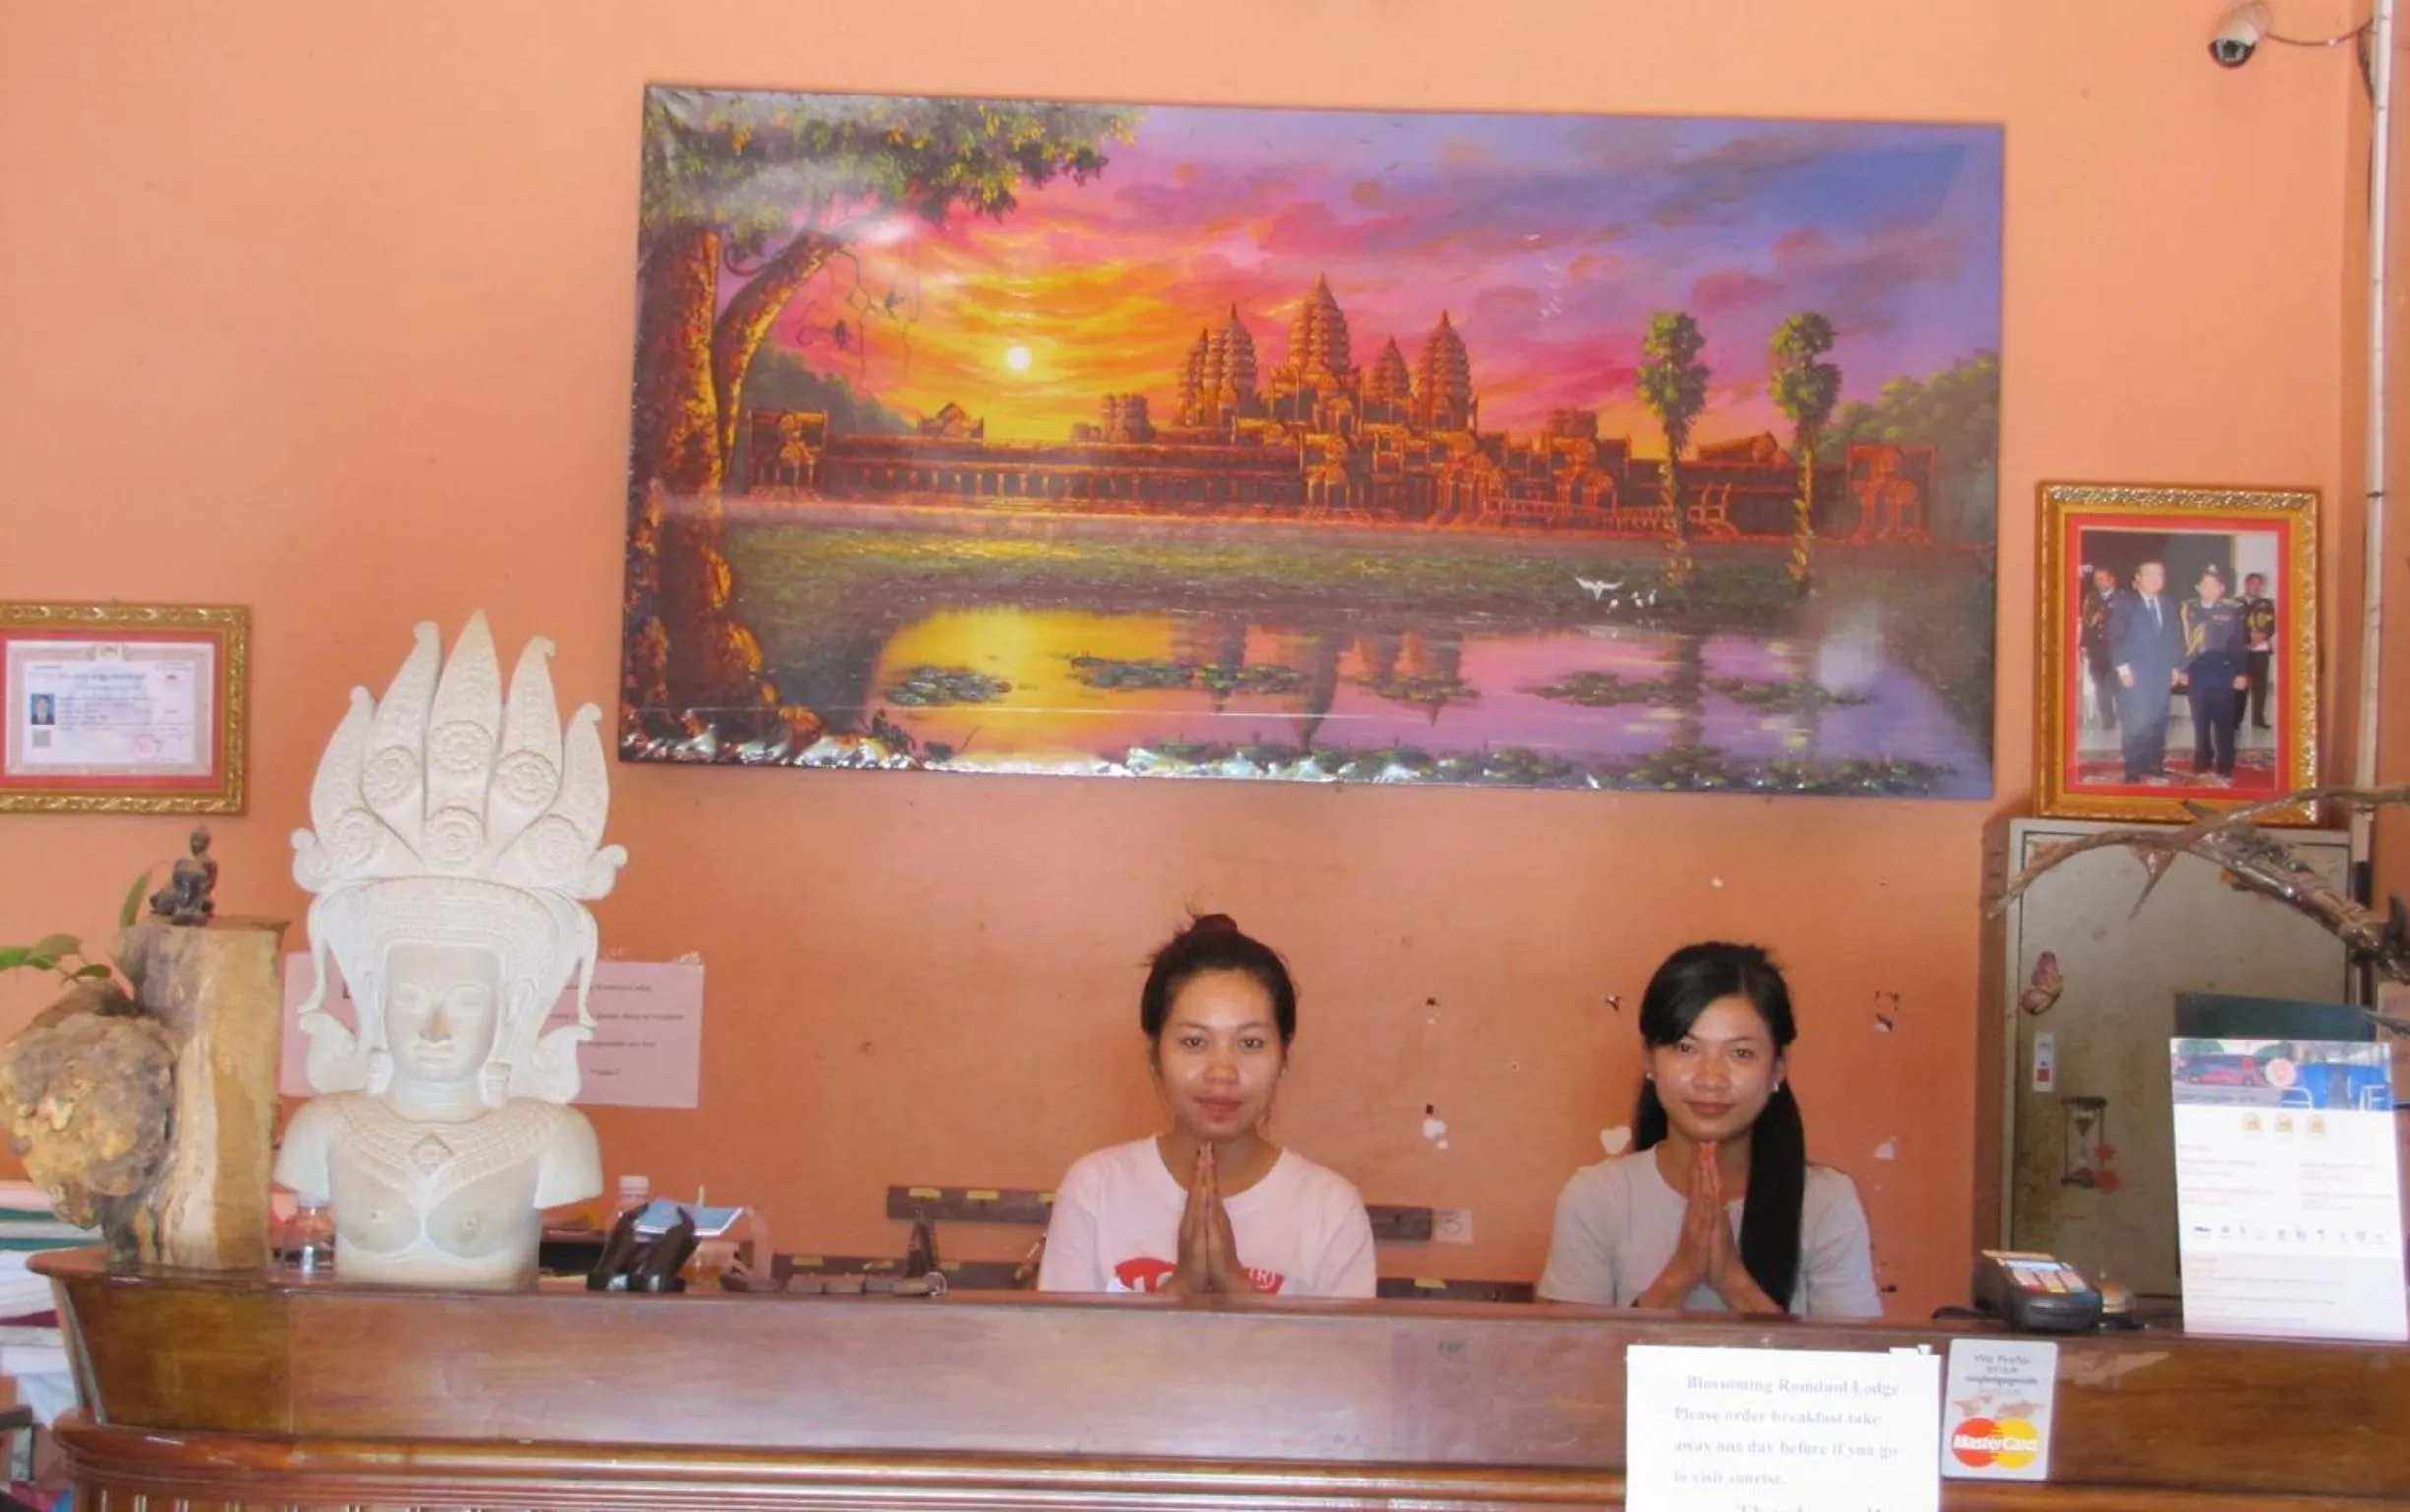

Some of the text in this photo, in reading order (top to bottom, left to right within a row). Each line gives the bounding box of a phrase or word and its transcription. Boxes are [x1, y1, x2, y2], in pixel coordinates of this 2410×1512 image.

[1686, 1375, 1900, 1396] Blossoming Romduol Lodge
[1673, 1405, 1881, 1425] Please order breakfast take
[1673, 1439, 1899, 1461] away one day before if you go
[1691, 1471, 1723, 1484] visit
